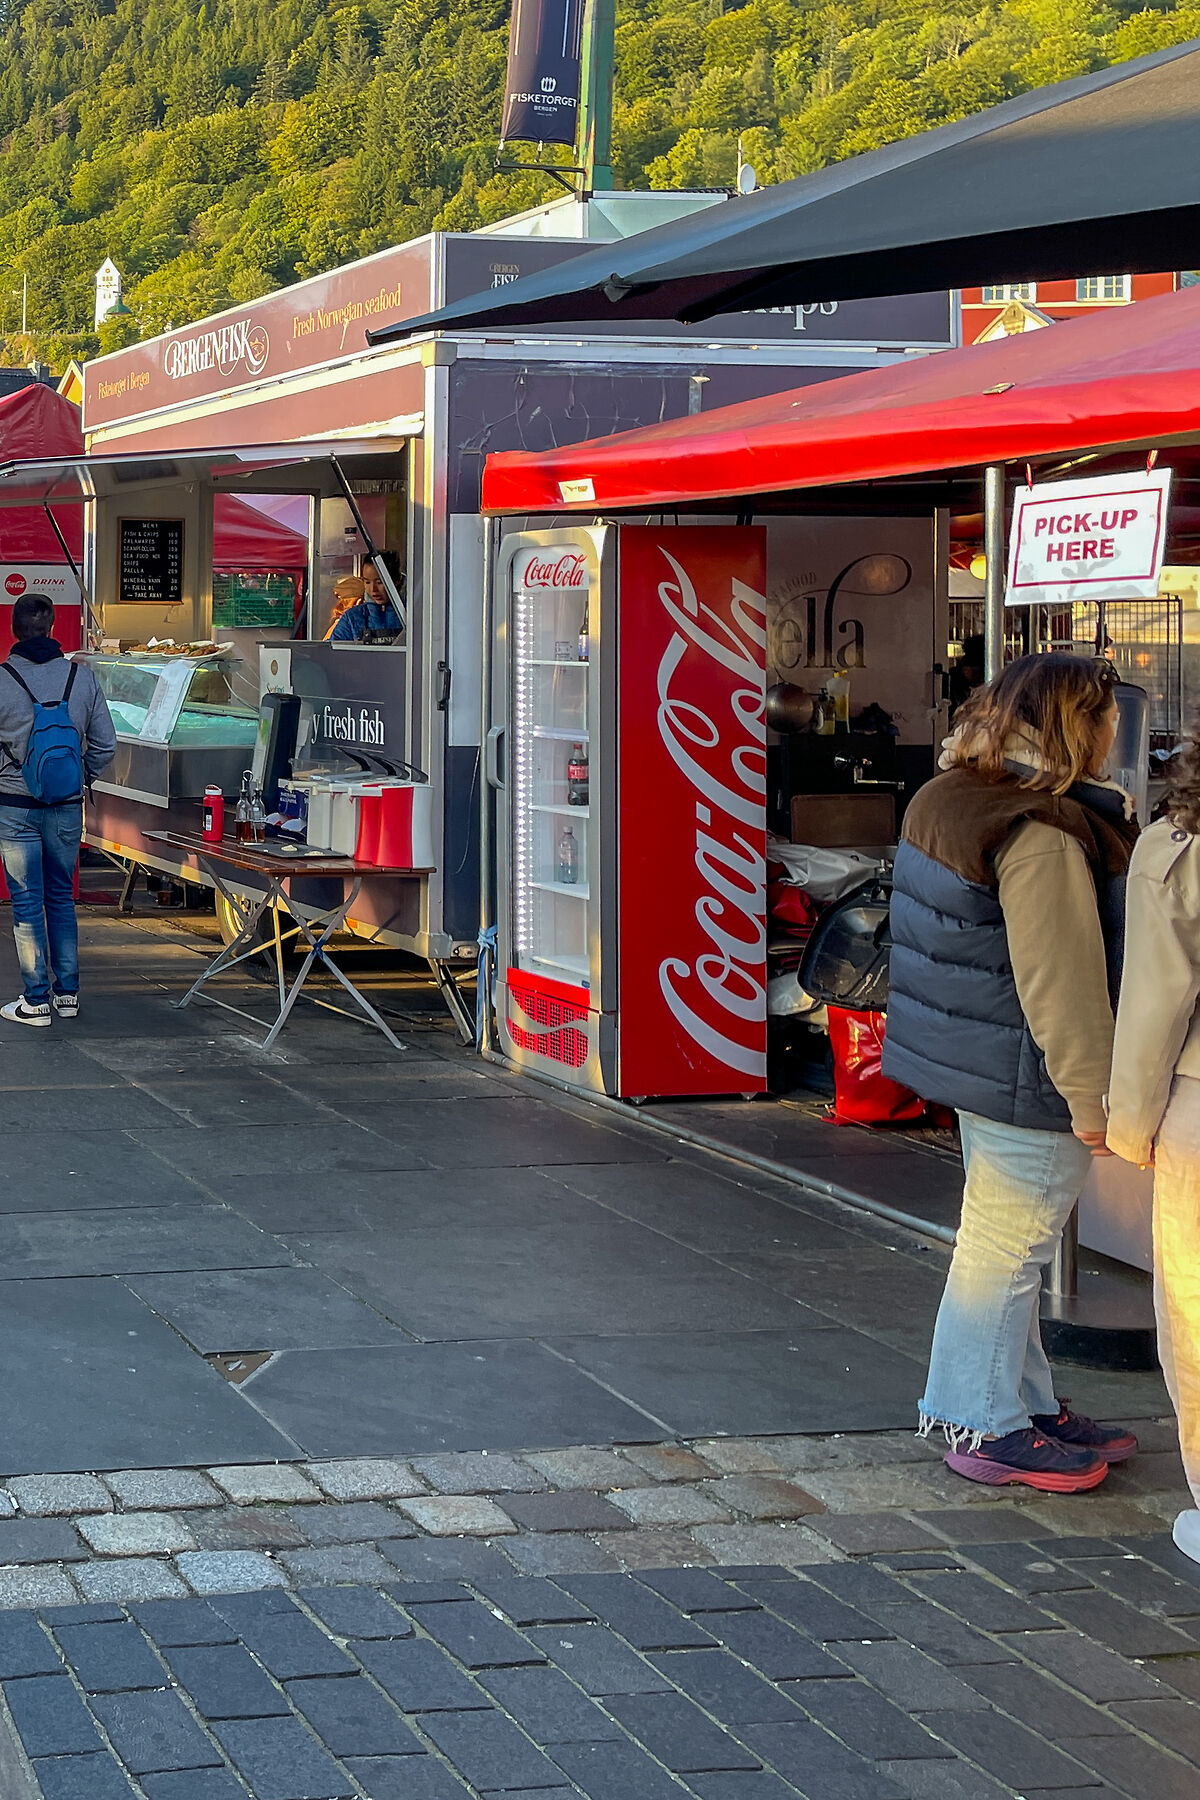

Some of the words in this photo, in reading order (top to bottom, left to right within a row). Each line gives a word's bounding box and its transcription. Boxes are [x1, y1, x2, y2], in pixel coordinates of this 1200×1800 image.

[510, 93, 577, 108] FISKETORGET
[293, 312, 315, 339] Fresh
[317, 301, 363, 331] Norwegian
[364, 282, 401, 316] seafood
[130, 371, 150, 393] Bergen
[1034, 509, 1138, 537] PICK-UP
[1046, 538, 1115, 562] HERE
[524, 553, 587, 588] Coca-Cola
[323, 705, 357, 742] fresh
[359, 708, 385, 745] fish
[658, 545, 767, 1078] Coca-Cola
